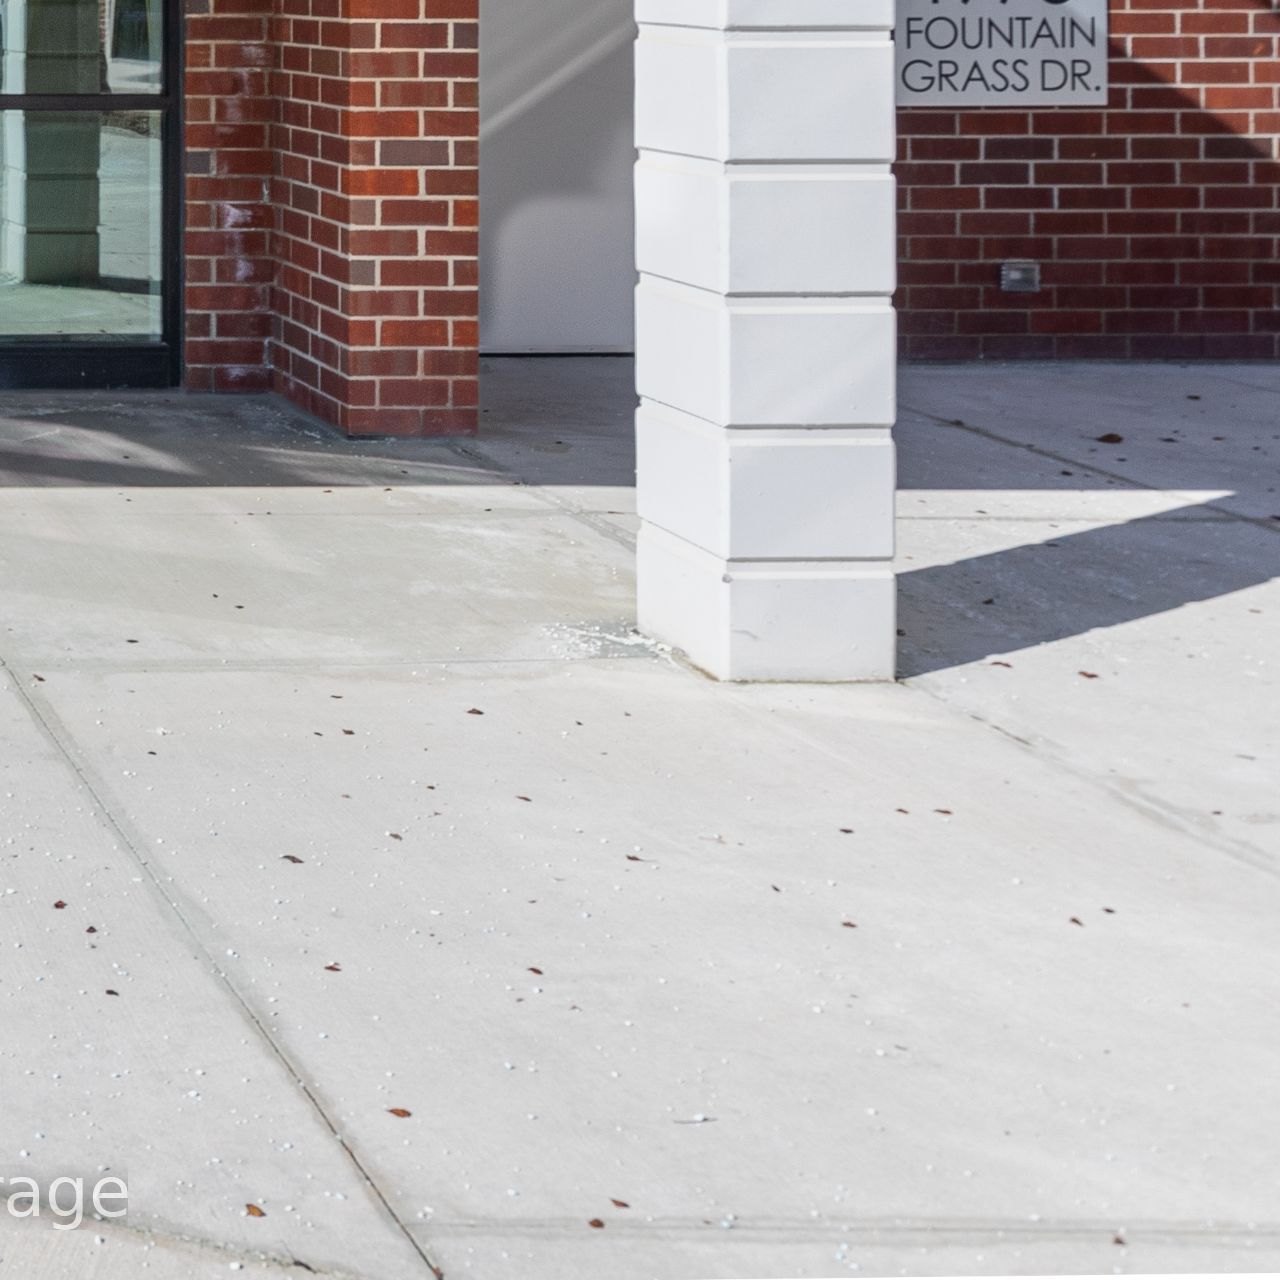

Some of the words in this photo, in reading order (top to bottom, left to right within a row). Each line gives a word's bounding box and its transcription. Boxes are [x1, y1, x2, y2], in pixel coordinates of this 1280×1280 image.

[906, 17, 1096, 49] FOUNTAIN
[901, 59, 1029, 92] GRASS
[1041, 59, 1101, 92] DR.
